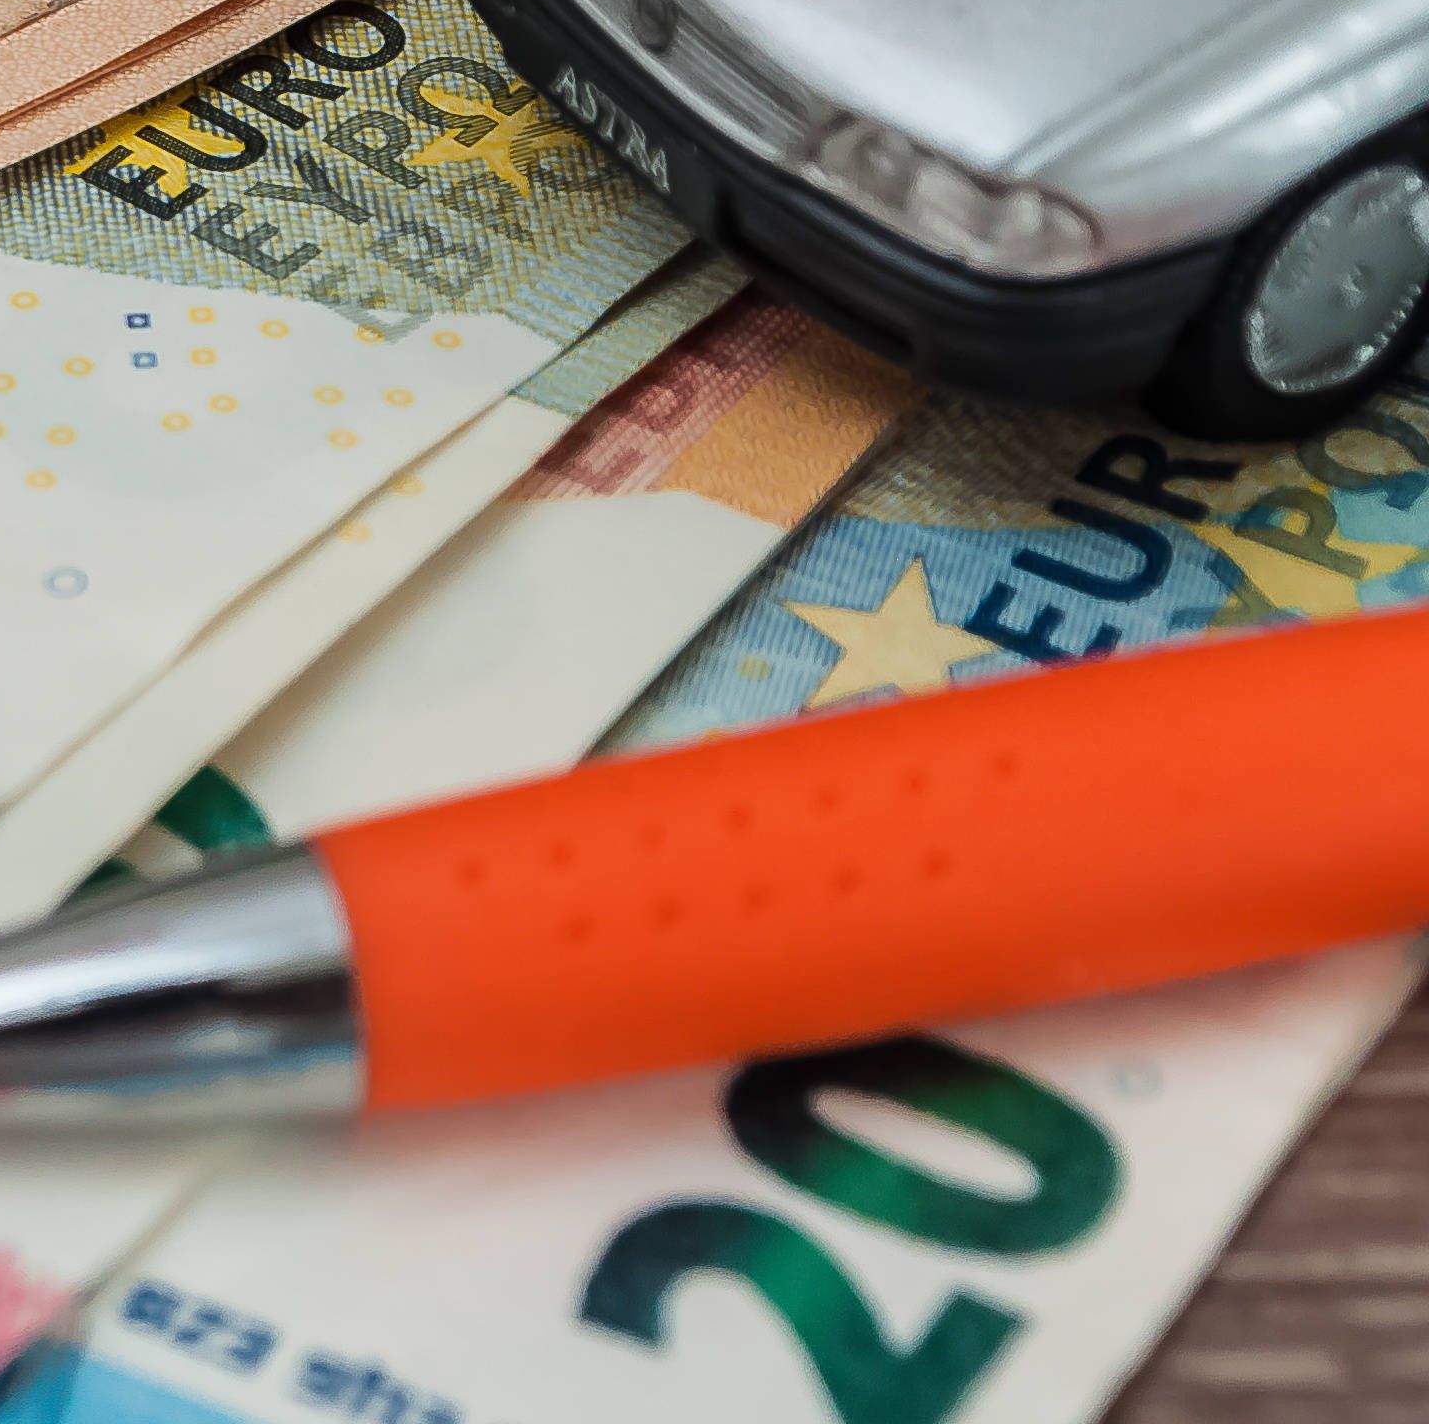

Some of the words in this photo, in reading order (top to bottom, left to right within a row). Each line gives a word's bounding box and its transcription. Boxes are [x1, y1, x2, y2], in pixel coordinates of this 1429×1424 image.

[73, 0, 407, 221] EURO
[963, 433, 1243, 668] EUR
[565, 1024, 1127, 1424] 20
